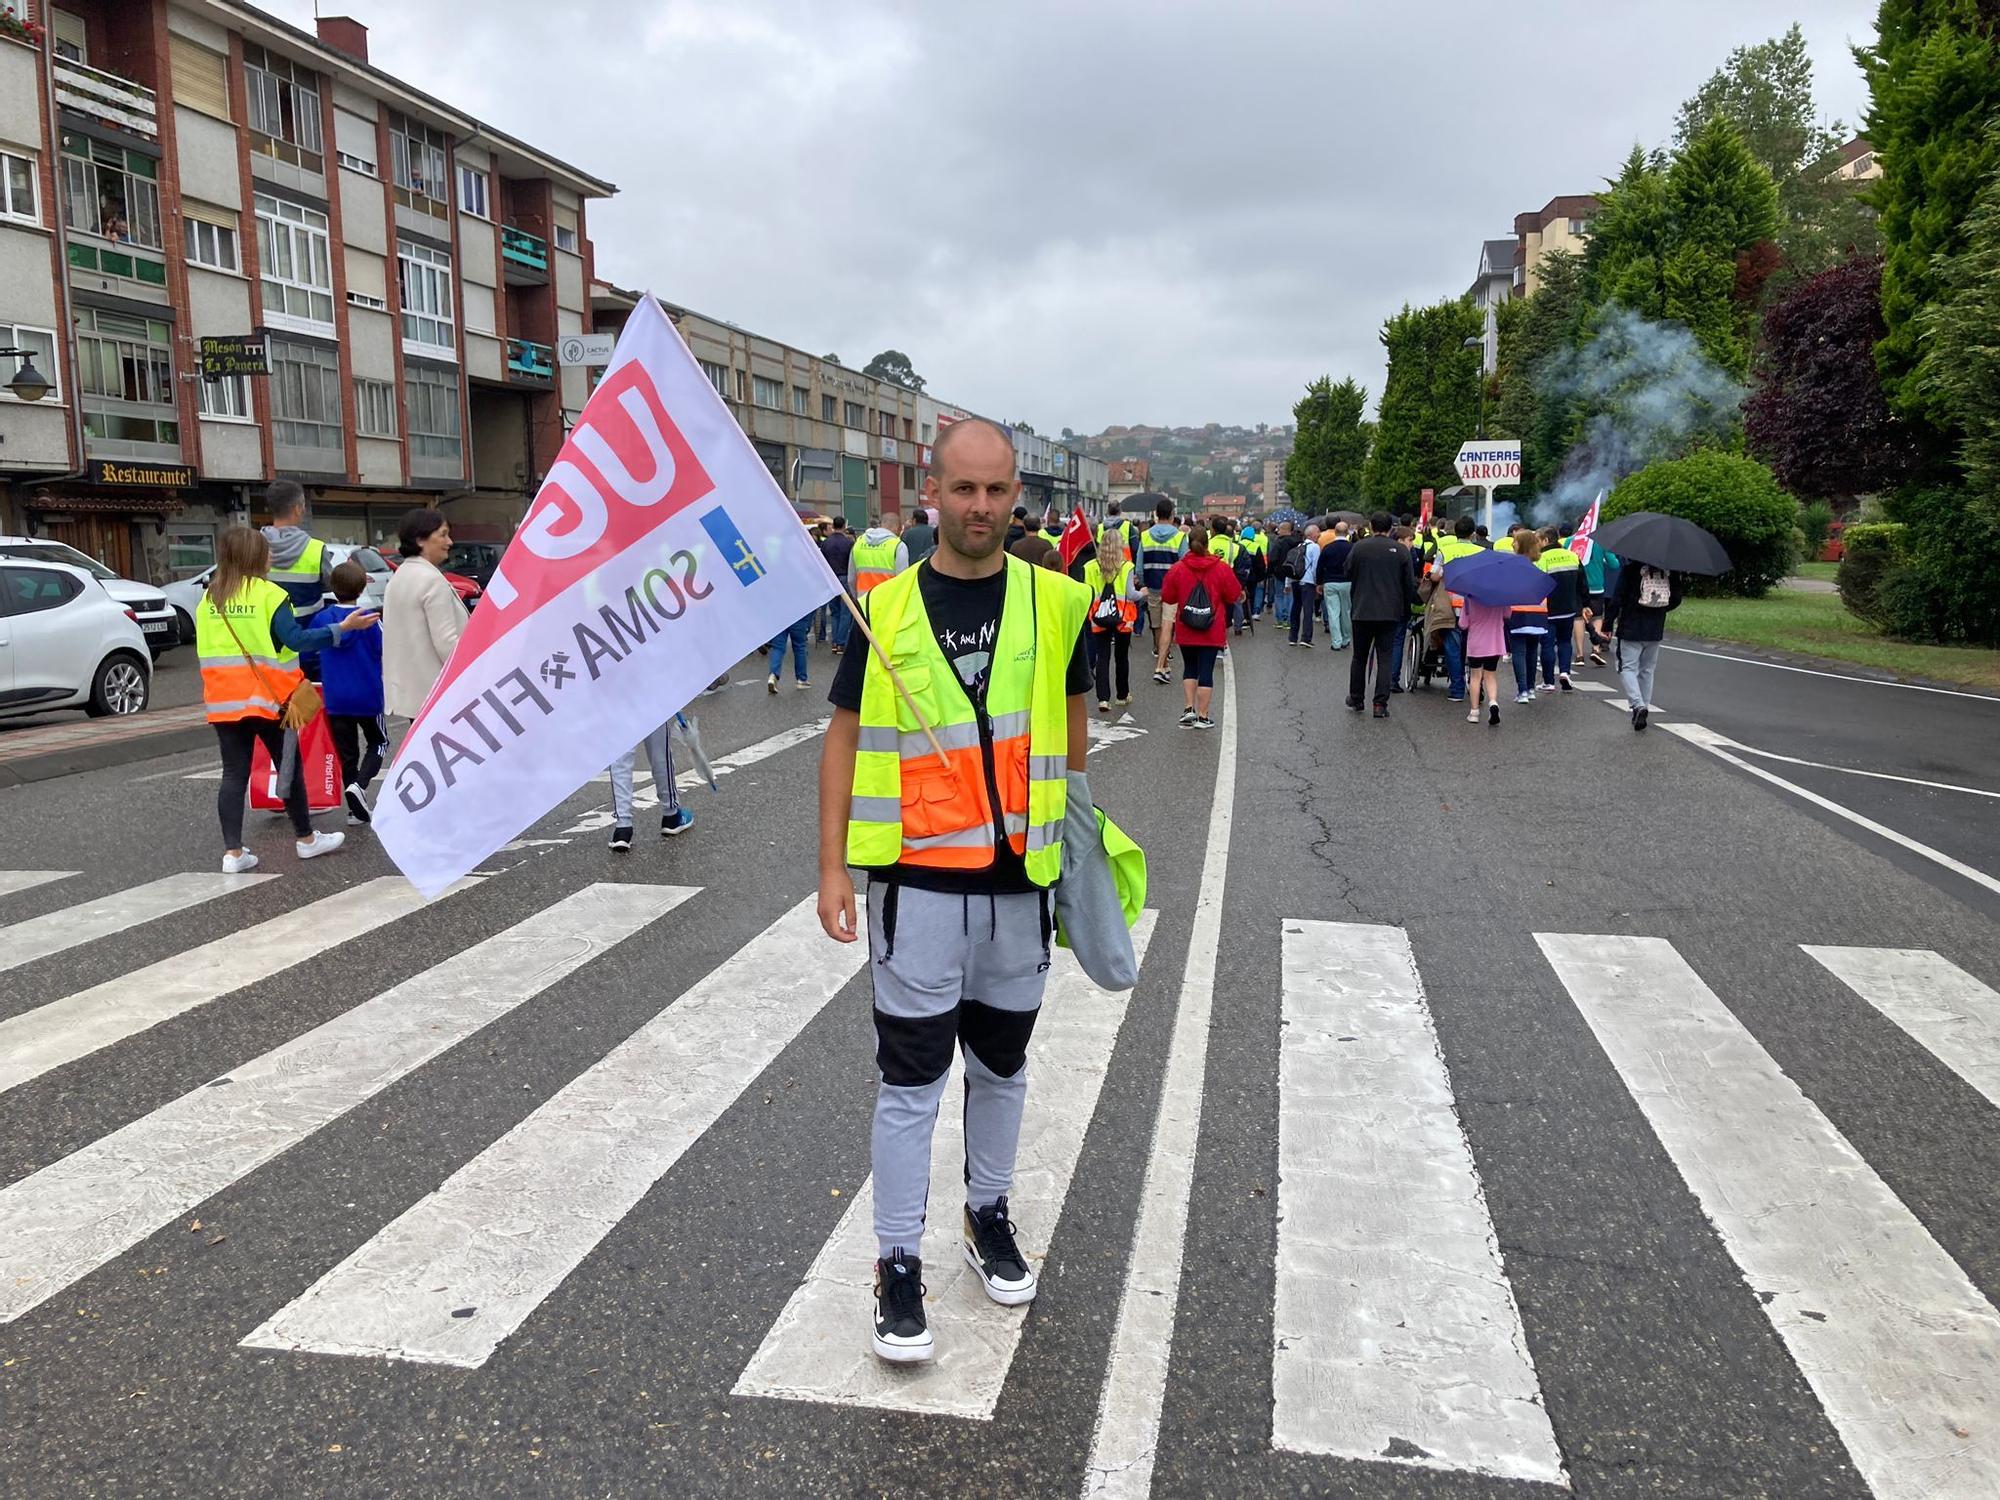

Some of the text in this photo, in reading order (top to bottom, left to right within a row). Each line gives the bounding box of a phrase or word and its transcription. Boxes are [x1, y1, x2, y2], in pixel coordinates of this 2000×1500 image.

[203, 339, 241, 355] Mesón
[204, 356, 265, 374] La Panera
[1460, 451, 1520, 462] CANTERAS
[1462, 463, 1521, 479] ARROJO
[324, 753, 335, 796] ASTURIAS
